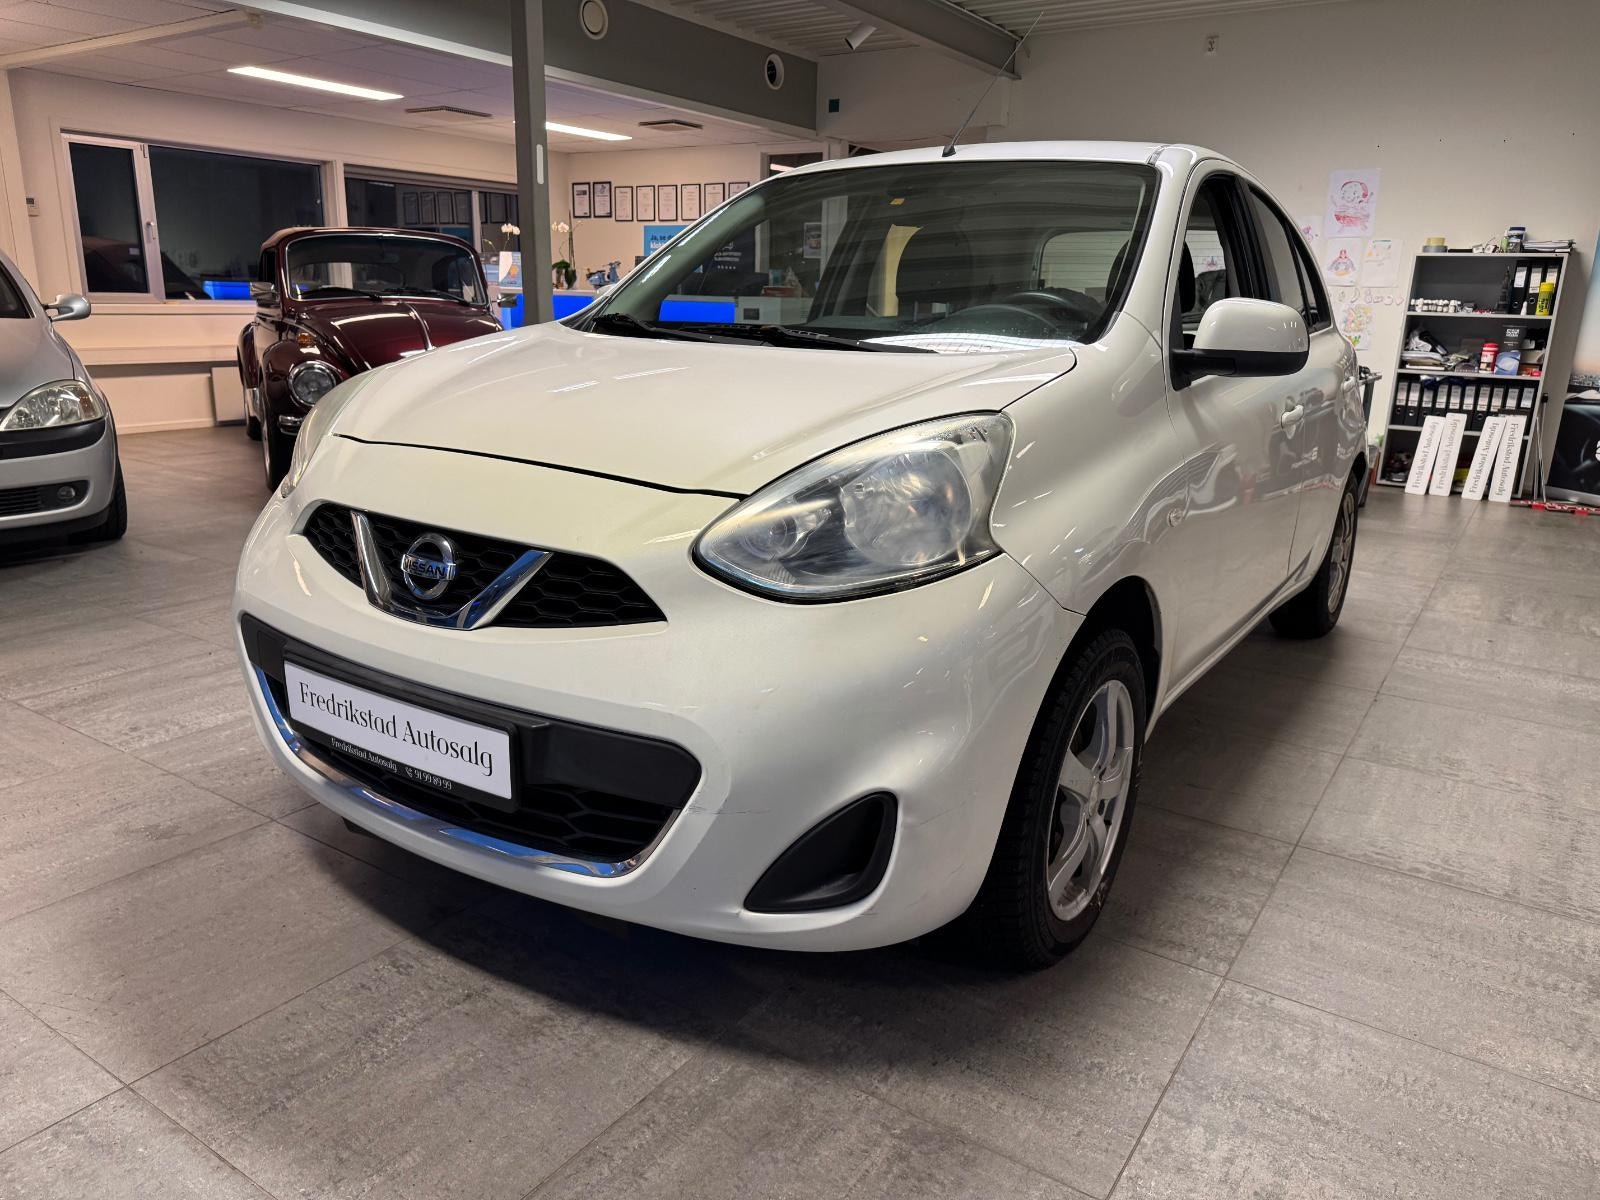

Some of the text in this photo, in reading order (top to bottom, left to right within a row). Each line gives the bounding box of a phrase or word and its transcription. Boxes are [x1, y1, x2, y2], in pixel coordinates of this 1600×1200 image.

[1469, 422, 1500, 493] Fredrikstad Autosalg
[1503, 422, 1519, 464] Fredrikstad
[404, 557, 445, 576] NISSAN
[298, 681, 493, 777] Fredrikstad Autosalg
[331, 737, 453, 790] Fredrikstad Autosalg 91 99 89 99
